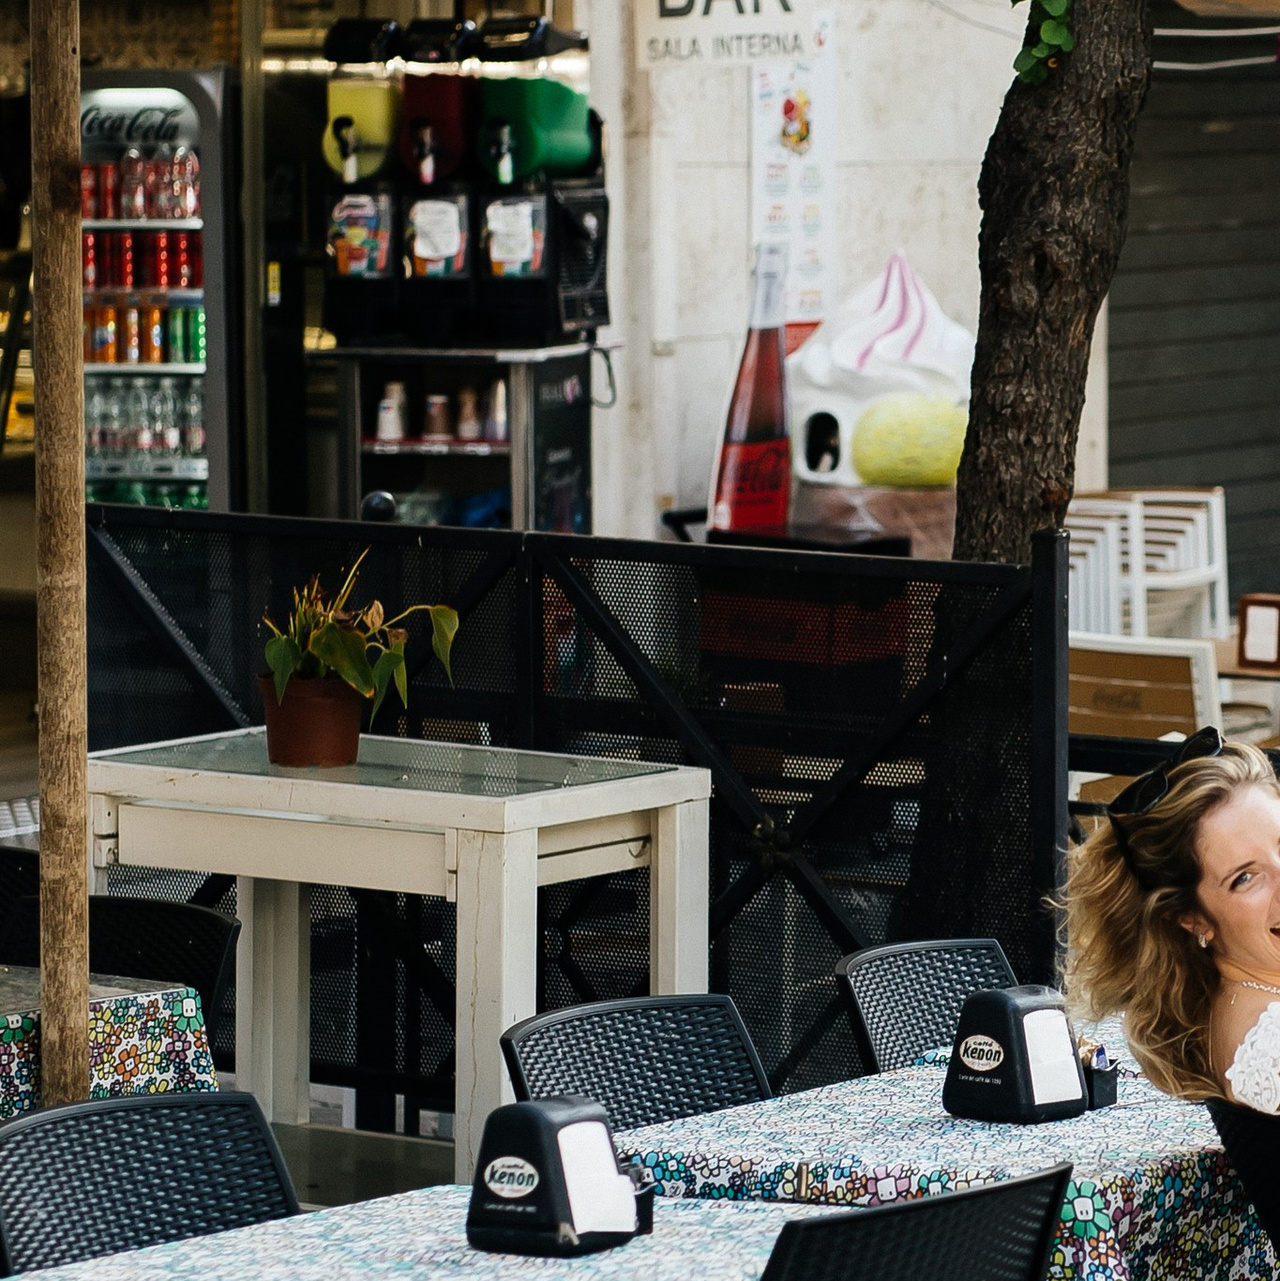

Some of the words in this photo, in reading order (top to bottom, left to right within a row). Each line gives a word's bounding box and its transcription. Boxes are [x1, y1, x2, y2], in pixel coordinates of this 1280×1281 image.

[647, 34, 703, 62] SALA
[711, 31, 803, 57] INTERNA
[962, 1040, 1002, 1063] kenon
[488, 1164, 535, 1187] kenon
